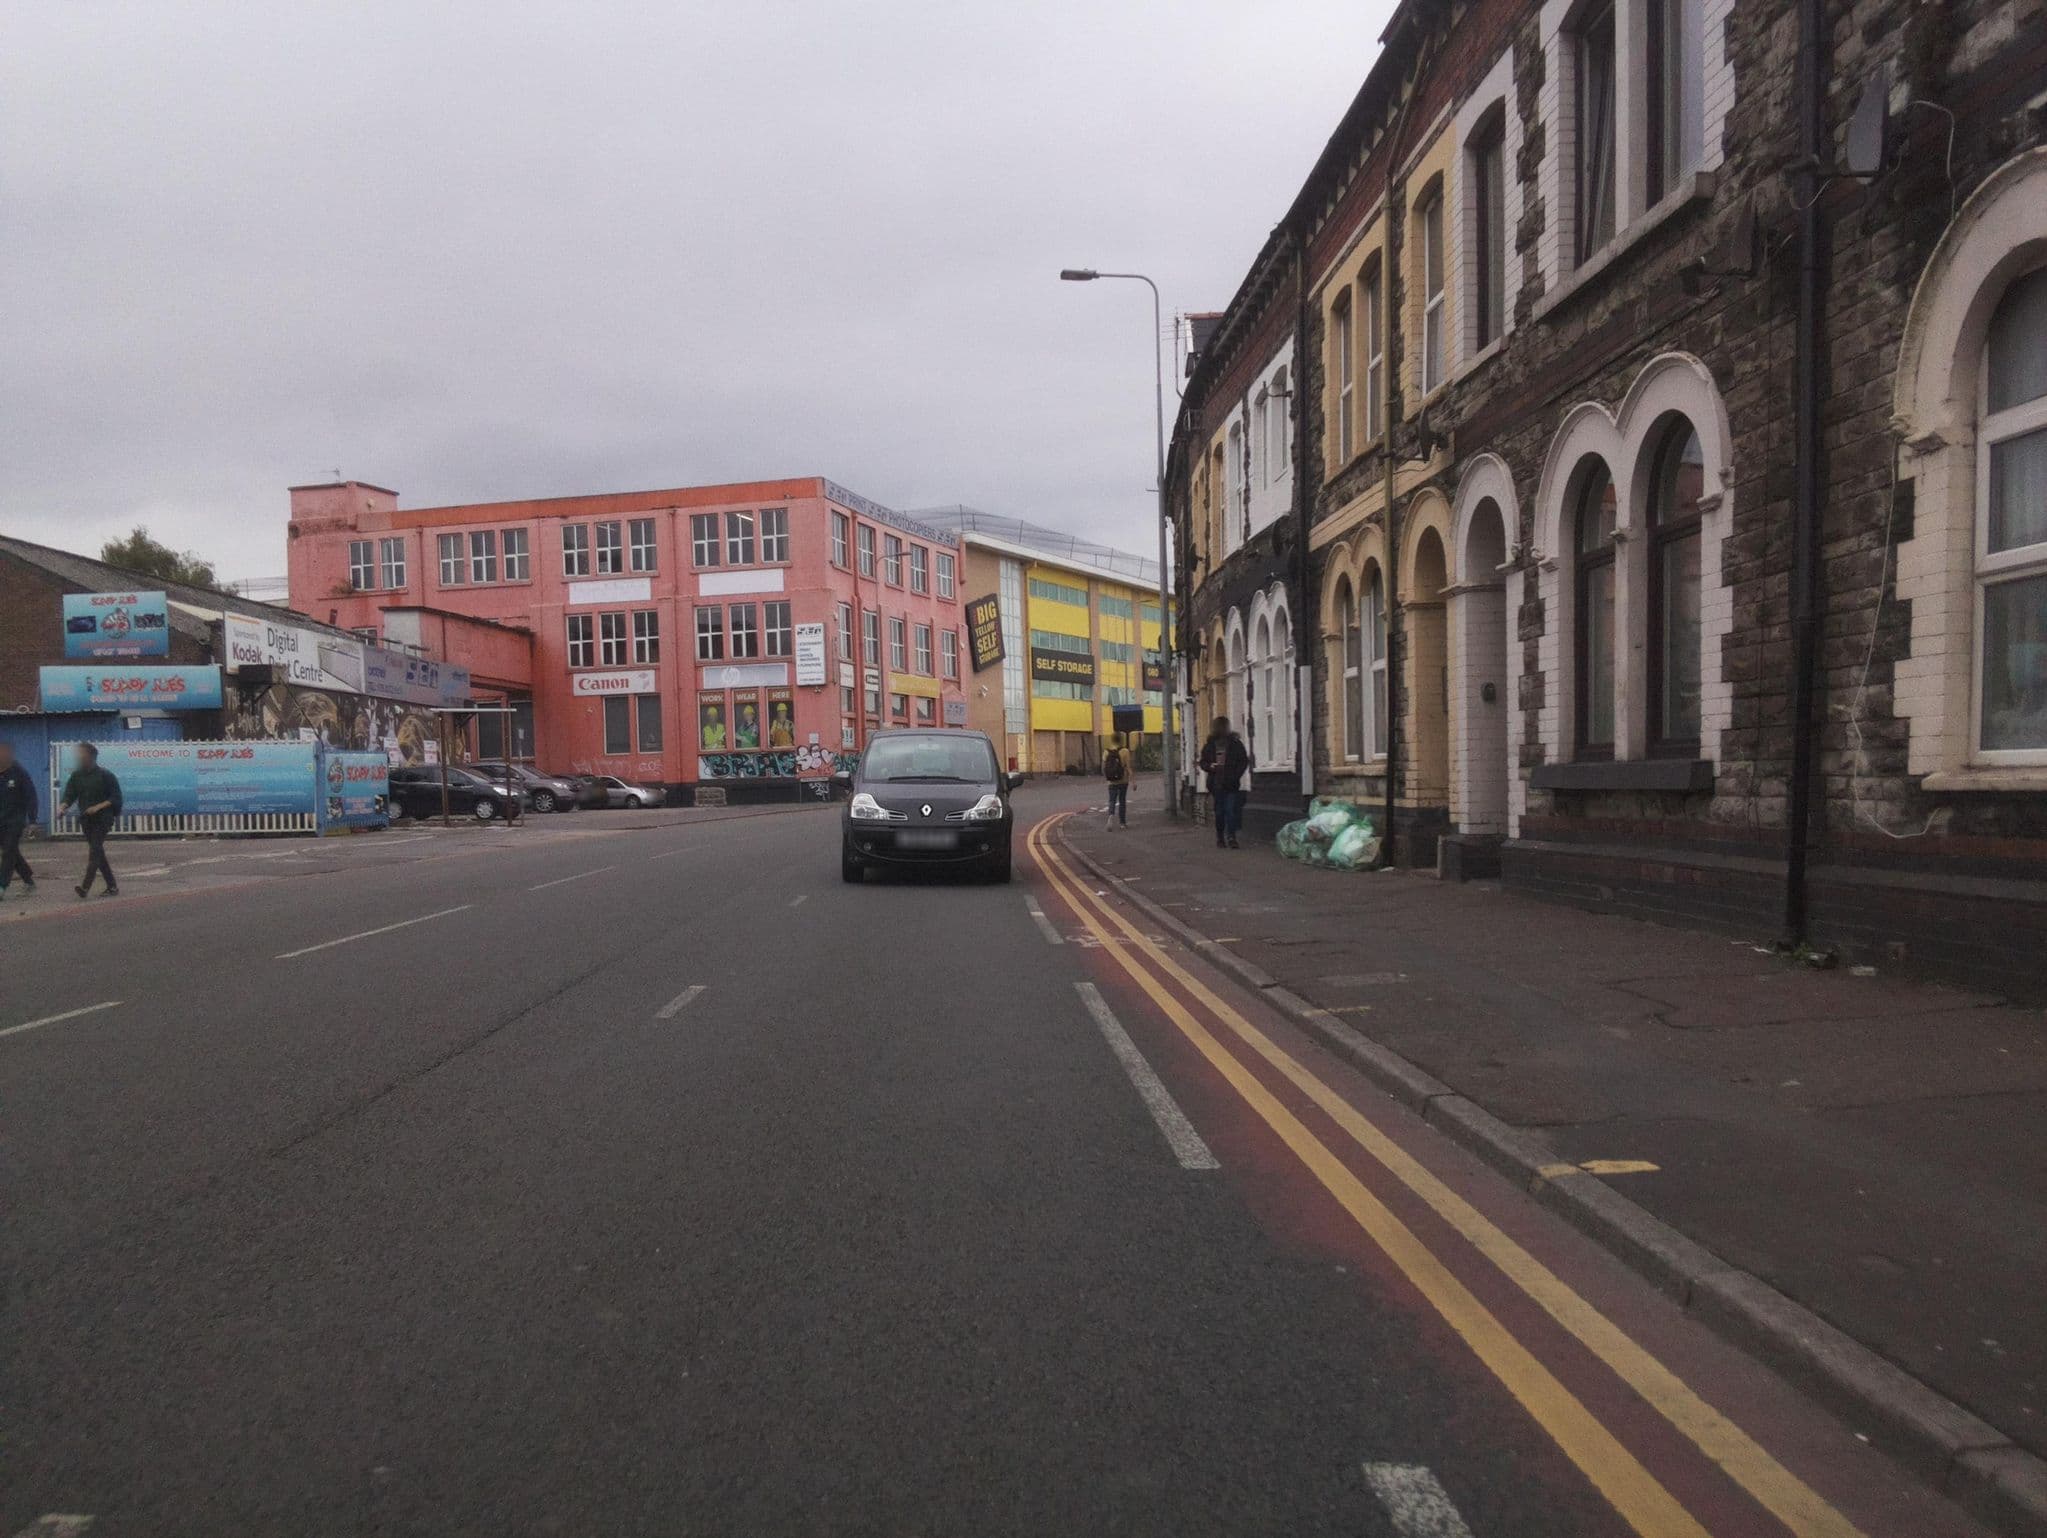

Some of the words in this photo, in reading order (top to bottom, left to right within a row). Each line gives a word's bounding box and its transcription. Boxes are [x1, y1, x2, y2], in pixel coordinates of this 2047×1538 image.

[888, 511, 937, 538] PHOTOCOPIERS
[976, 601, 998, 625] BIG
[975, 621, 996, 637] YELLOW
[267, 628, 299, 654] Digital
[977, 632, 997, 654] SELF
[232, 642, 263, 665] Kodak
[979, 648, 1001, 665] STORAGE
[294, 660, 324, 683] Centre
[1036, 658, 1057, 670] SELF
[1057, 660, 1093, 675] STORAGE
[578, 677, 630, 691] Canon
[701, 694, 723, 703] WORK
[736, 692, 757, 701] WEAR
[772, 690, 790, 699] HERE
[128, 749, 175, 758] WELCOME
[178, 749, 190, 758] TO
